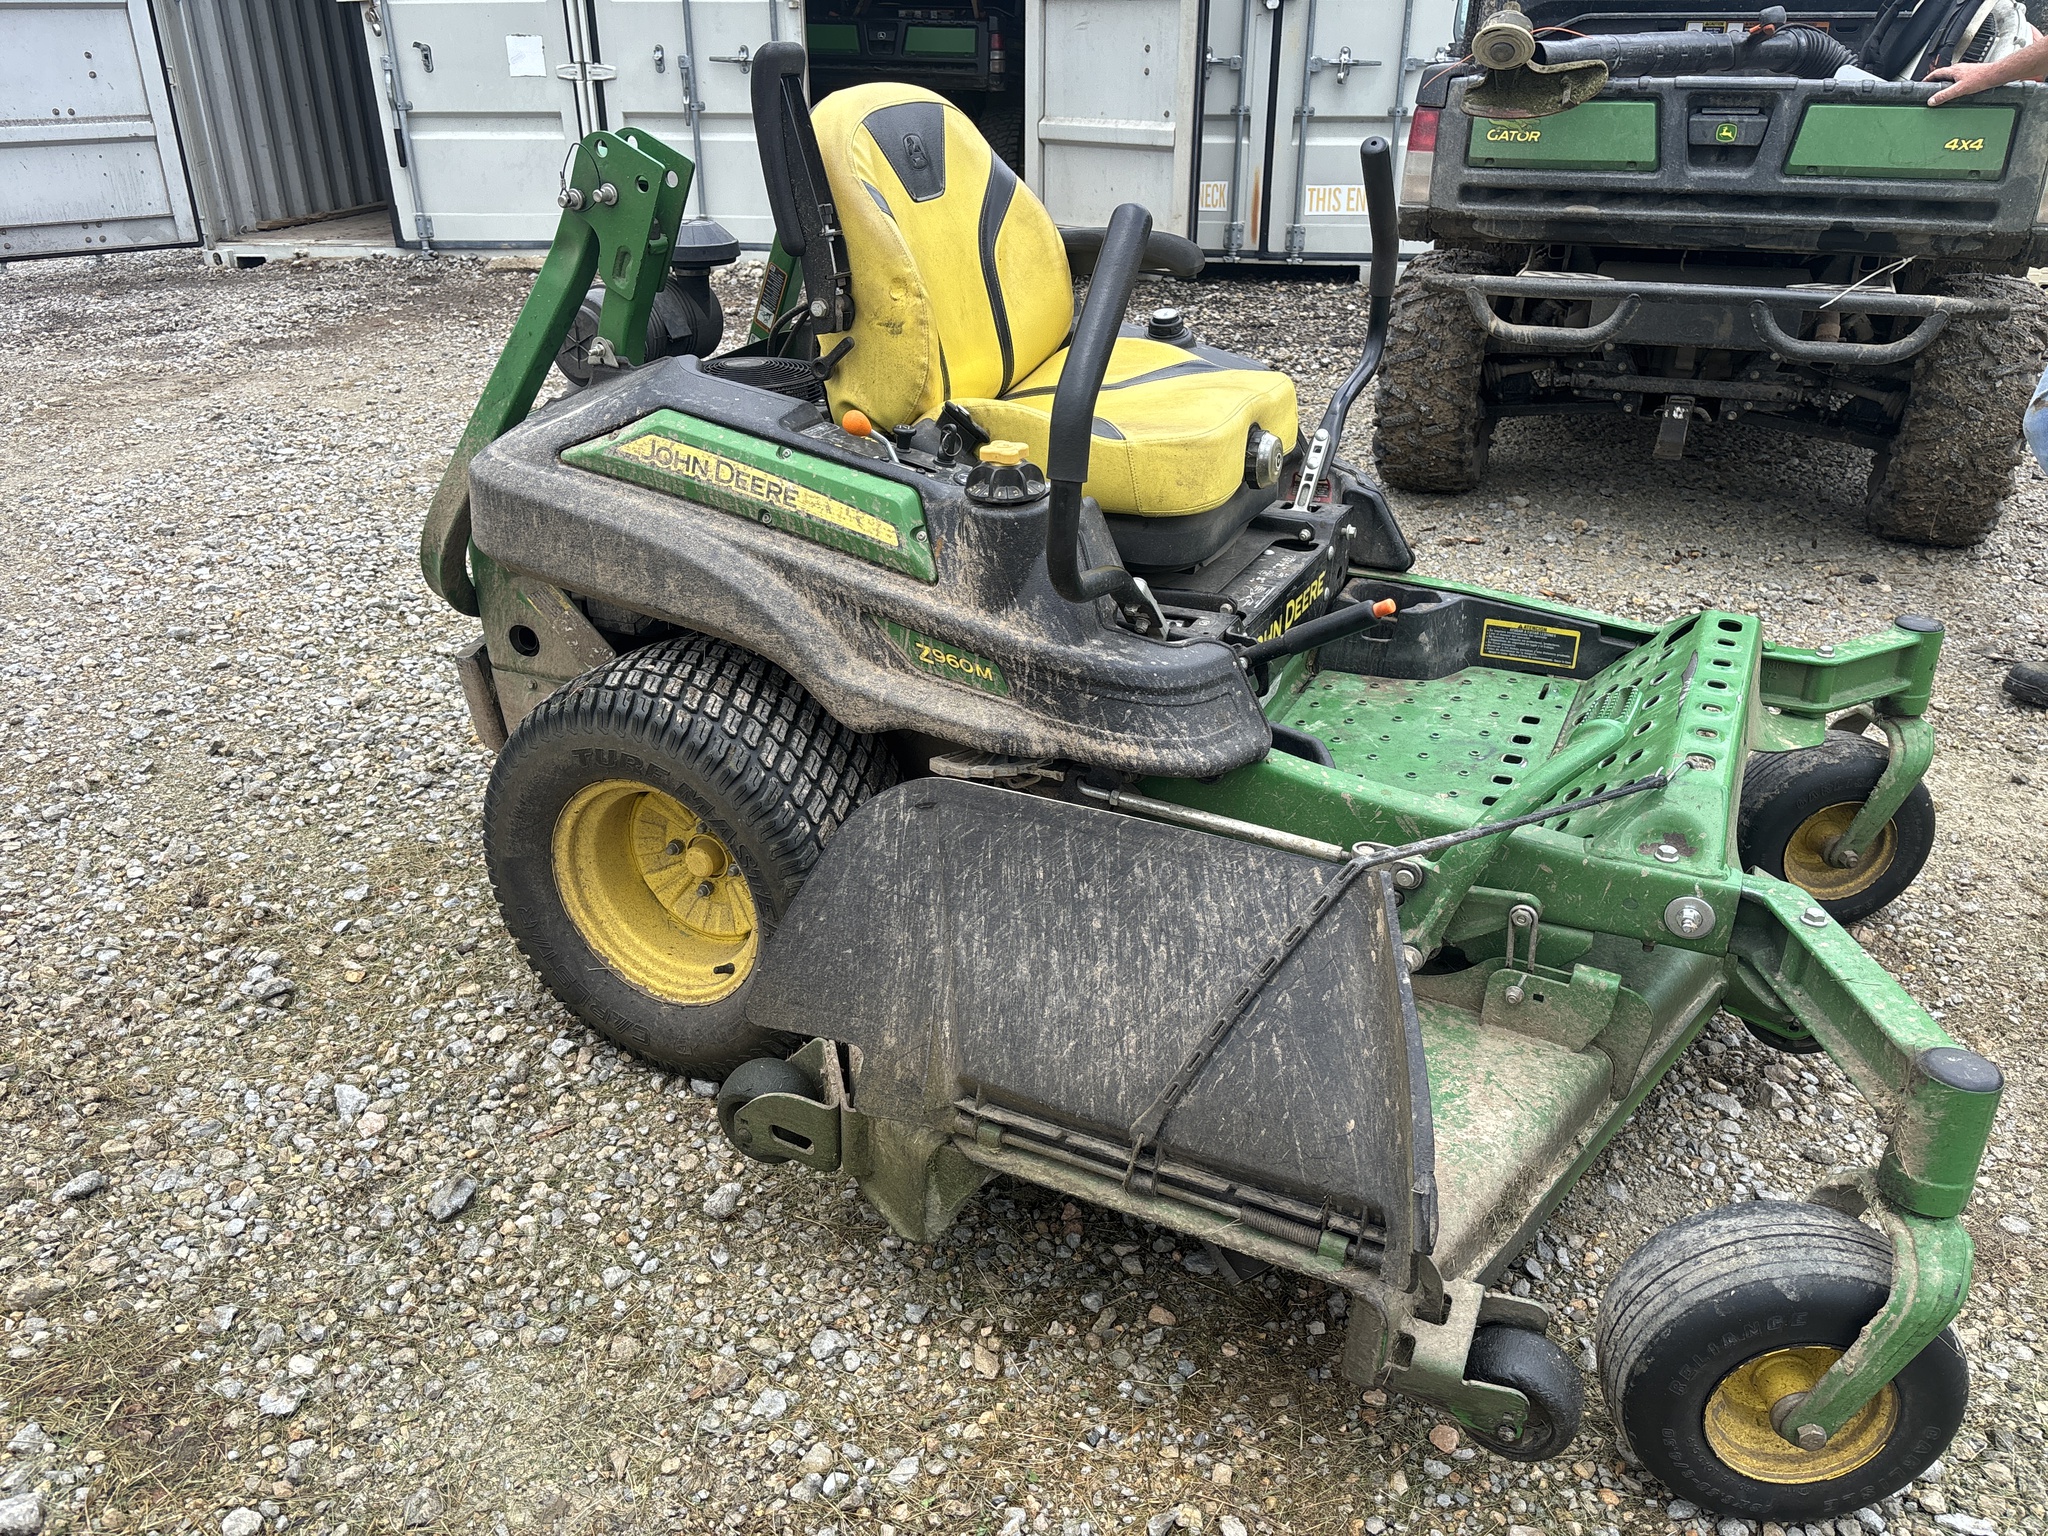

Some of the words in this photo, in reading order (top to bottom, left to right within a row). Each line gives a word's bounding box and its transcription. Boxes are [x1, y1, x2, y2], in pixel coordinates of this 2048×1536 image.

[1486, 129, 1541, 142] GATOR
[1308, 187, 1341, 212] THIS
[1346, 187, 1368, 212] EN
[641, 439, 709, 477] JOHN
[714, 459, 800, 509] DEERE
[1257, 613, 1283, 643] HN
[1284, 570, 1327, 631] DEERE
[915, 641, 993, 682] Z960M
[1796, 777, 1875, 809] CARLISL
[571, 748, 670, 780] TURF
[675, 781, 779, 944] MASTER
[1669, 1311, 1808, 1396] RELIANCE
[1824, 1425, 1942, 1513] CARLISLE
